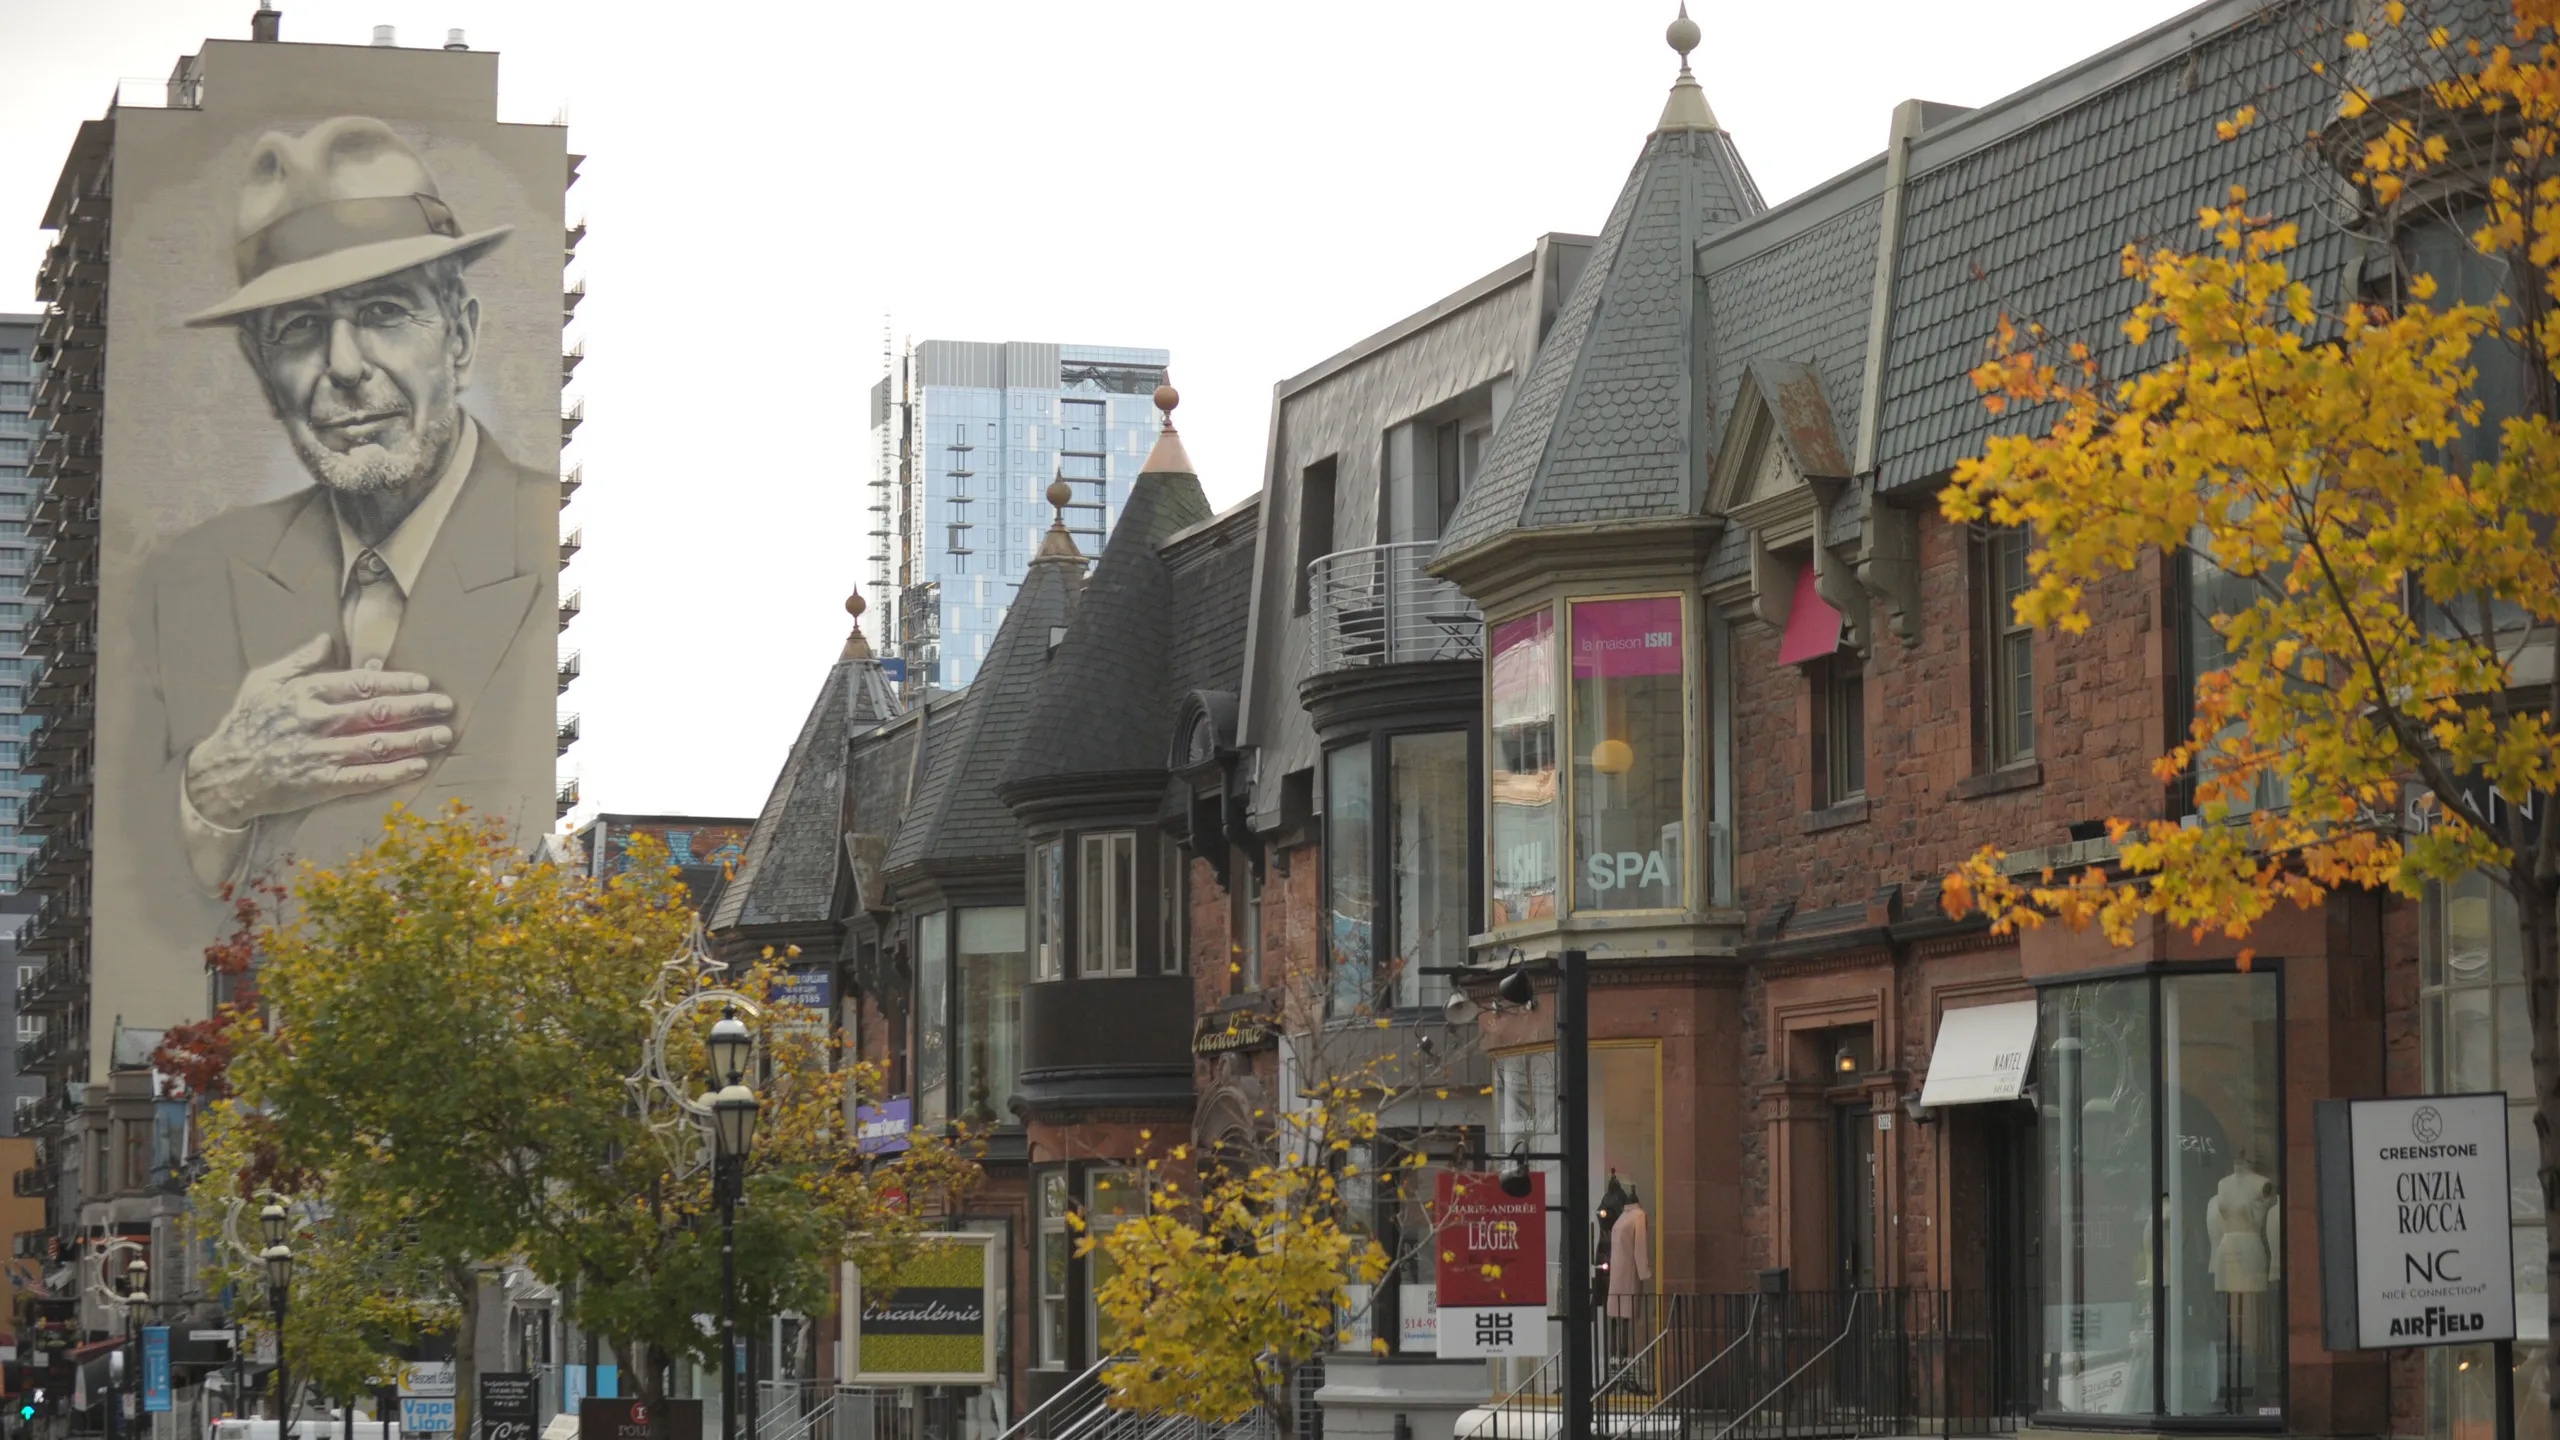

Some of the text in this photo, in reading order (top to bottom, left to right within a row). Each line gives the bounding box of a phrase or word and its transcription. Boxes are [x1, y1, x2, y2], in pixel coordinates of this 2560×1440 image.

[1582, 632, 1672, 650] la maison ISHI
[1587, 851, 1671, 890] SPA
[1993, 1052, 2021, 1072] NANTEL
[2380, 1143, 2478, 1160] CREENSTONE
[2397, 1171, 2465, 1202] CINZIA
[1448, 1202, 1537, 1214] MARIE-ANDRÉE
[2398, 1202, 2467, 1234] ROCCA
[1468, 1217, 1519, 1250] LÉGER
[2405, 1250, 2462, 1284] NC
[2382, 1289, 2404, 1300] NICE
[403, 1399, 452, 1417] Vape
[408, 1415, 447, 1430] Lion
